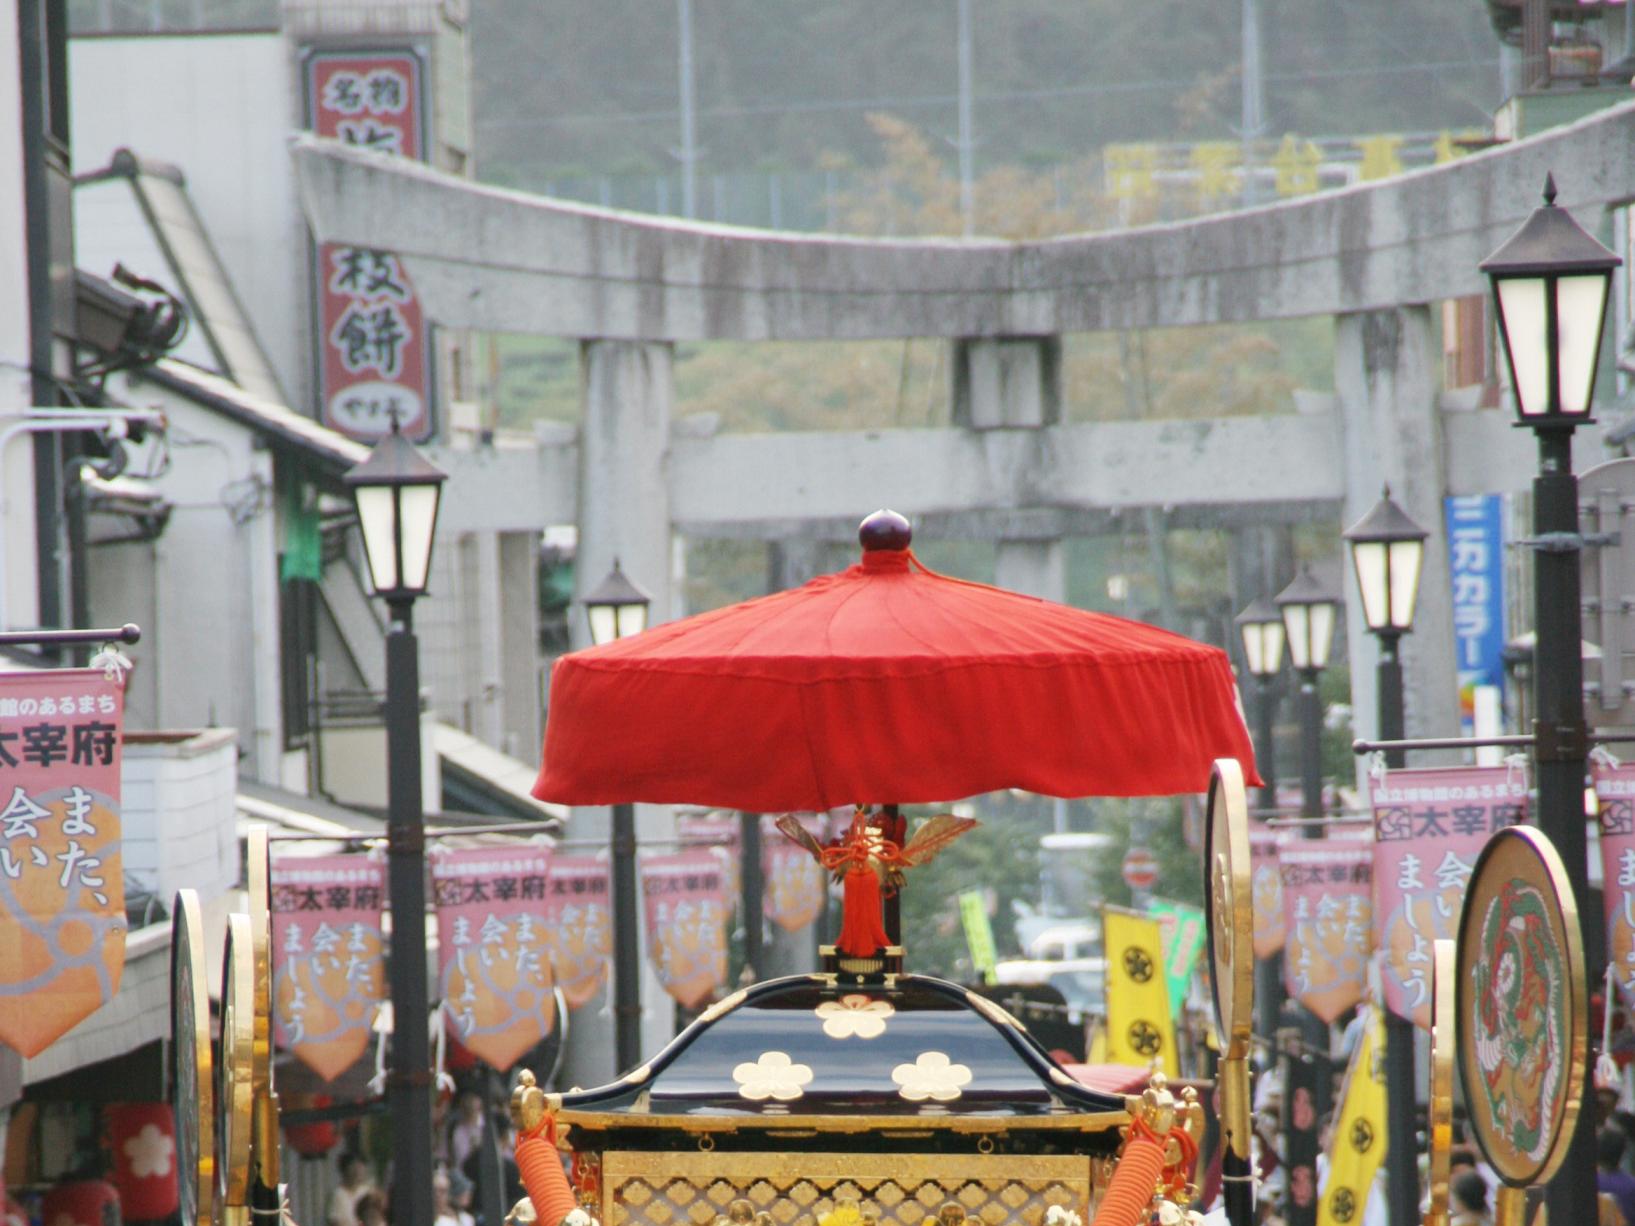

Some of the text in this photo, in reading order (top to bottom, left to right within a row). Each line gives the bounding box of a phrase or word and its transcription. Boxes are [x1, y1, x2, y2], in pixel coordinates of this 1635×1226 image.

[0, 696, 116, 717] 館のあるまち
[0, 785, 52, 878] 会い
[300, 886, 380, 912] 太宰府
[464, 876, 546, 902] 太宰府
[311, 921, 342, 977] 会い
[480, 912, 510, 967] 会い
